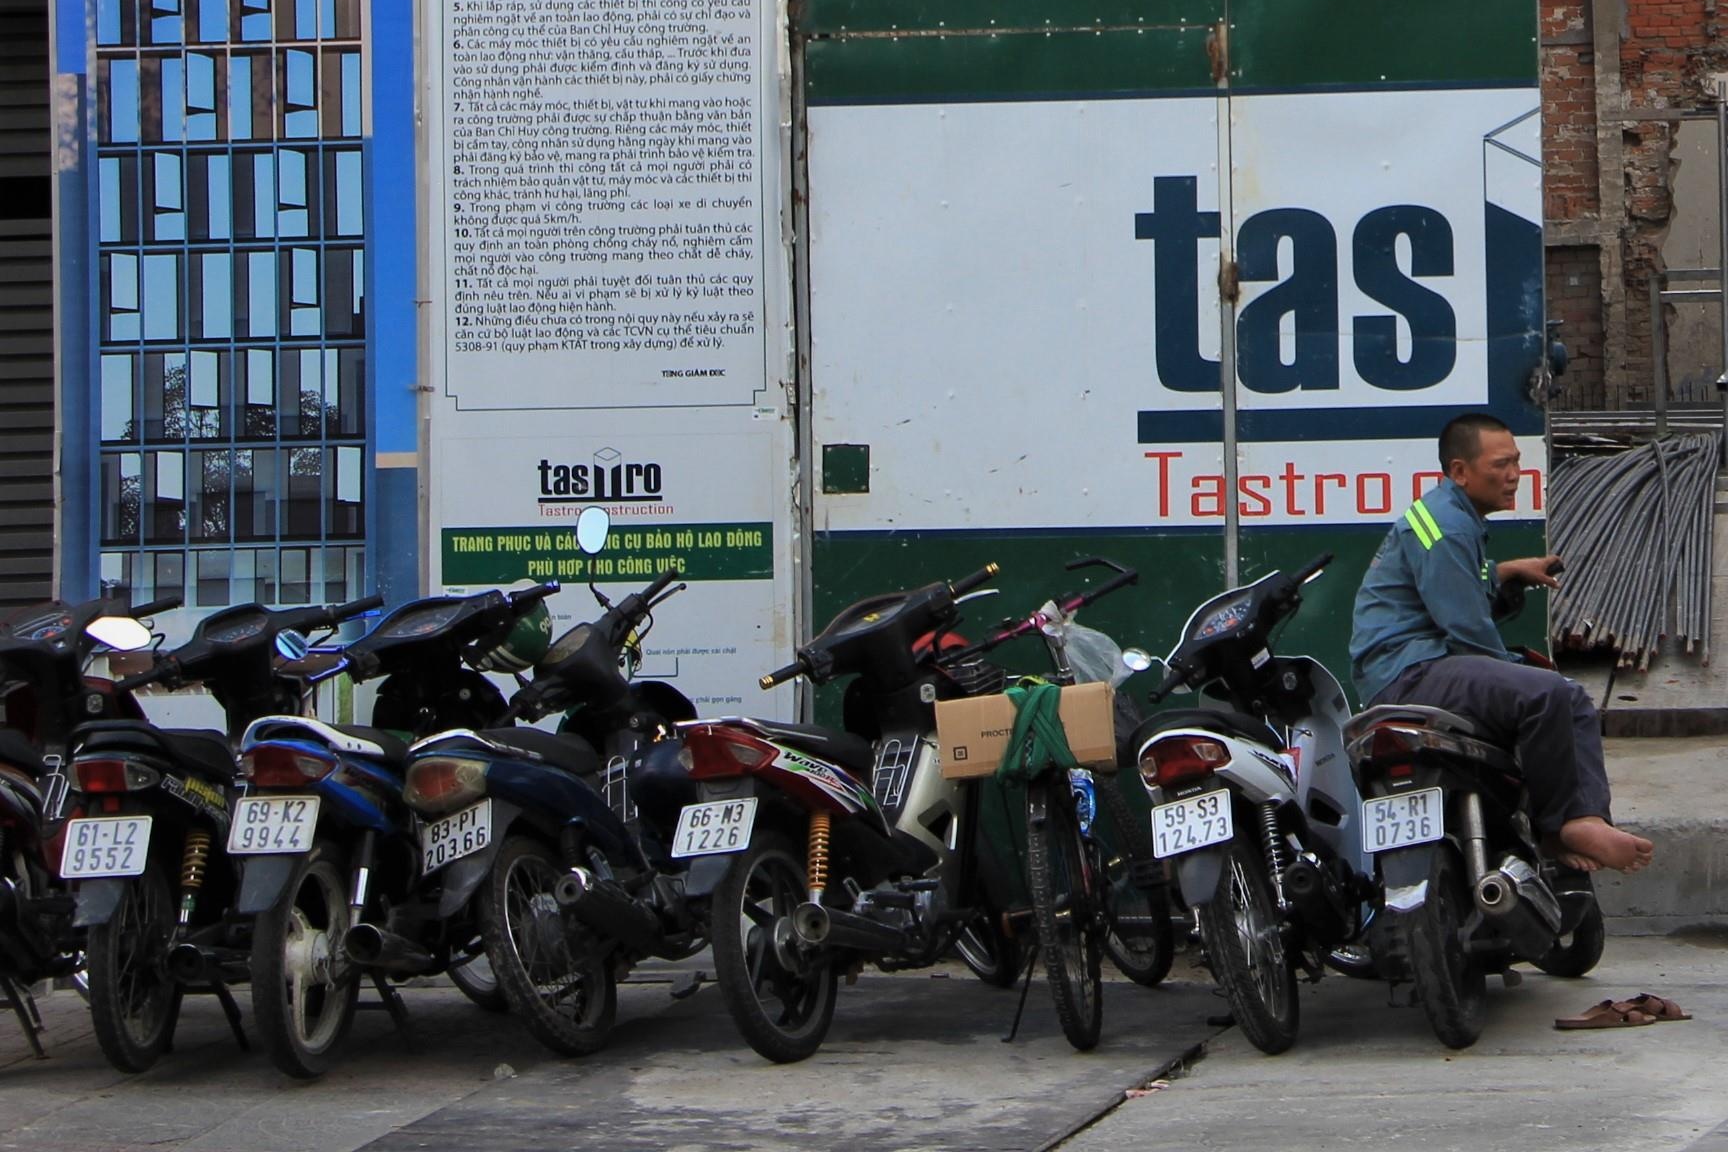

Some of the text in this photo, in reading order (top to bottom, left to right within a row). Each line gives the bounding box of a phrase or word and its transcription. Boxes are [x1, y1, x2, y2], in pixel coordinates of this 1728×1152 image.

[1144, 451, 1392, 517] Tastro
[453, 535, 493, 552] TRANG
[497, 535, 531, 554] PHỤC
[535, 532, 551, 551] VÀ
[624, 534, 642, 553] CỤ
[646, 529, 672, 549] BẢO
[676, 532, 693, 552] HỘ
[698, 530, 722, 548] LAO
[726, 528, 762, 550] ĐỘNG
[528, 557, 553, 576] PHÙ
[558, 559, 582, 578] HỢP
[618, 555, 652, 574] CÔNG
[247, 800, 307, 826] 69-K2
[688, 804, 745, 831] 66-M3
[1164, 795, 1219, 828] 59-S3
[1375, 793, 1428, 823] 54-R1
[76, 821, 139, 847] 61-L2
[242, 825, 301, 851] 9944
[430, 804, 477, 845] 83-PT
[686, 825, 740, 850] 1226
[1159, 817, 1228, 854] 124.73
[1376, 816, 1431, 847] 0736
[73, 847, 133, 872] 9552
[425, 827, 487, 873] 203.66
